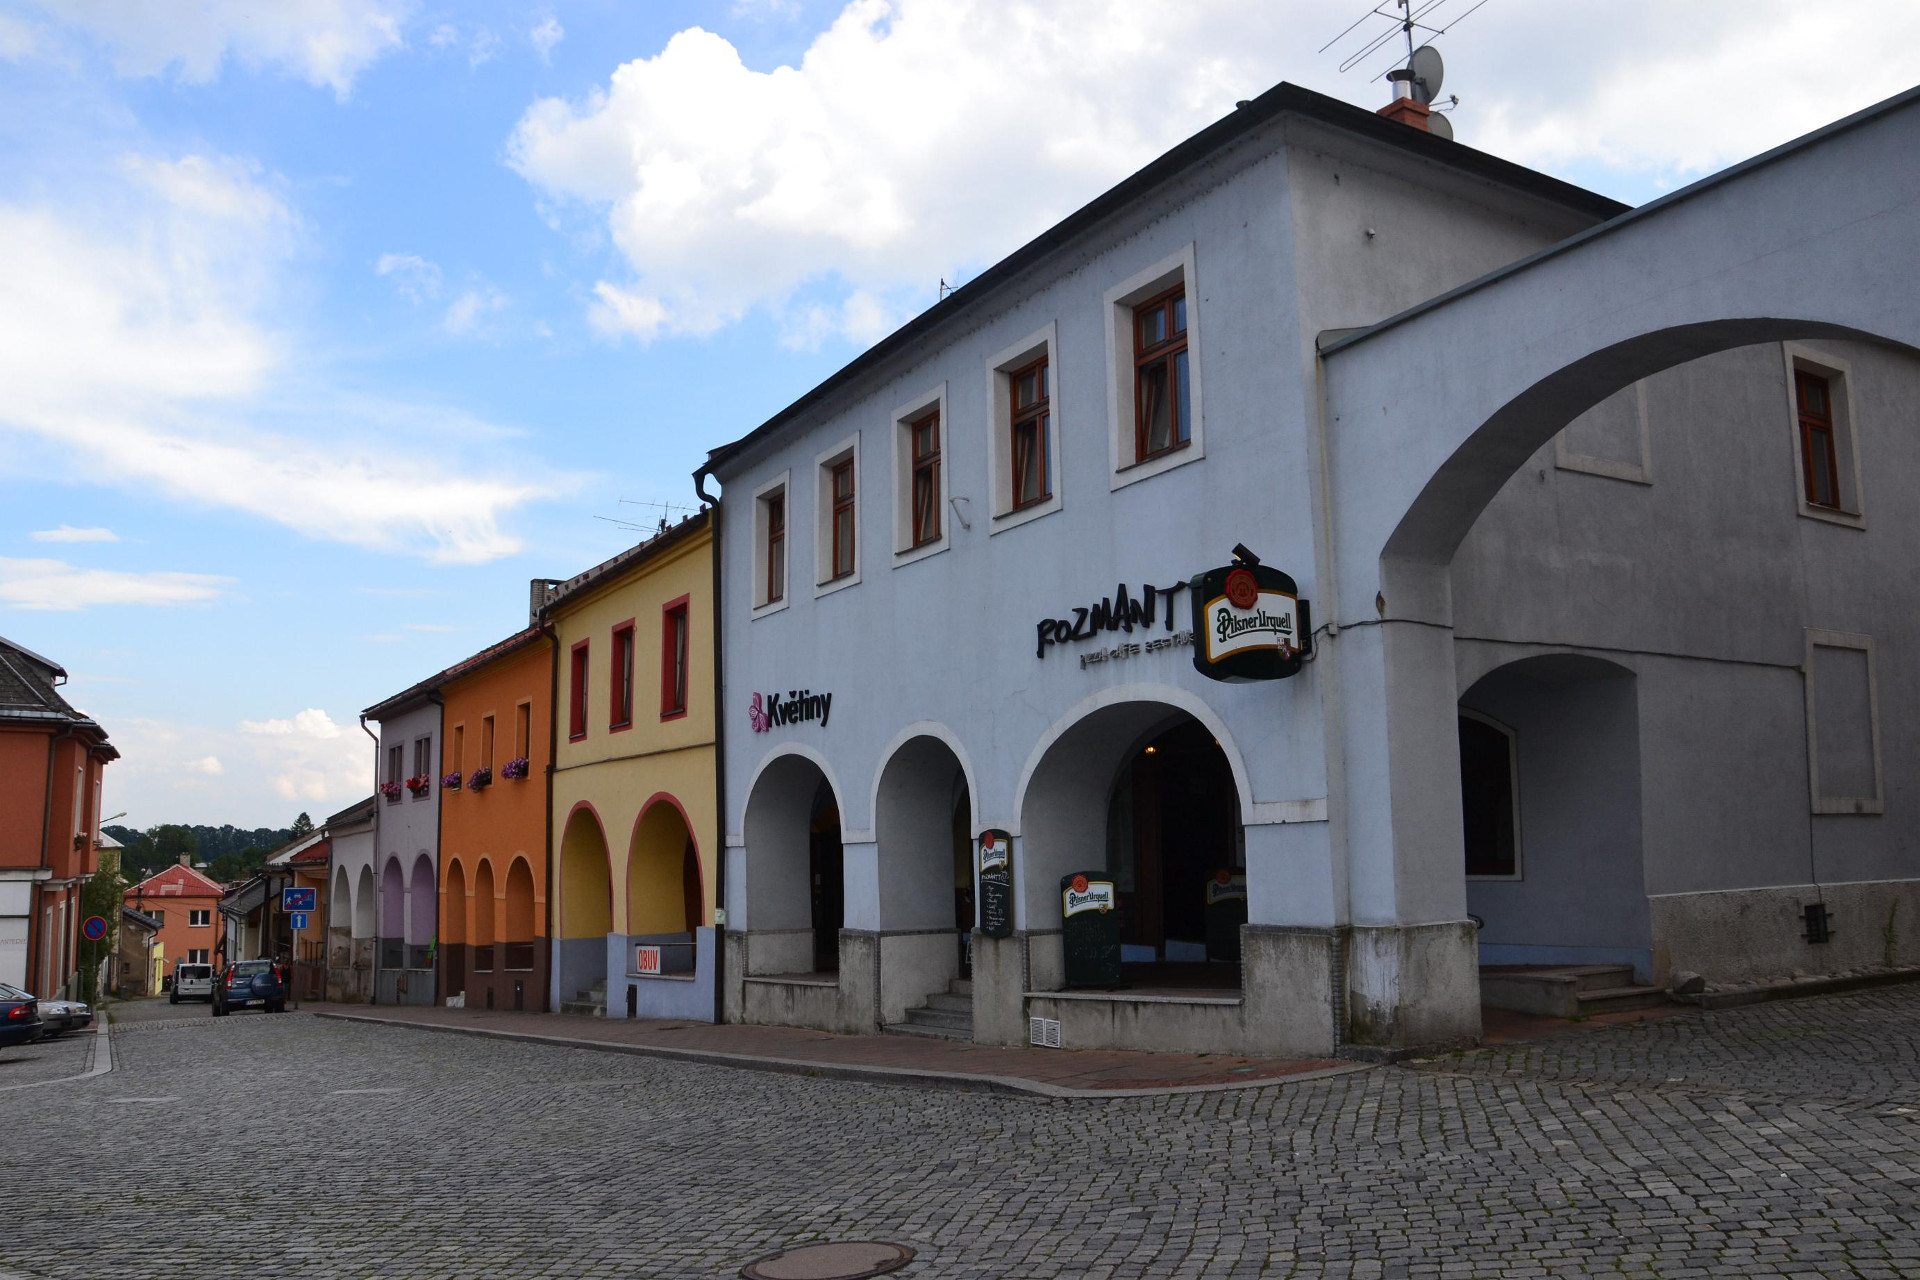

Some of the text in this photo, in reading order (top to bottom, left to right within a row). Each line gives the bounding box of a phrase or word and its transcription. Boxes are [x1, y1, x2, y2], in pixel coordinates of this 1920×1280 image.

[1216, 607, 1292, 643] Pilsner Urquell
[767, 689, 832, 728] Květiny
[1069, 891, 1109, 908] Pilsner Urquell
[638, 949, 658, 971] OBUV
